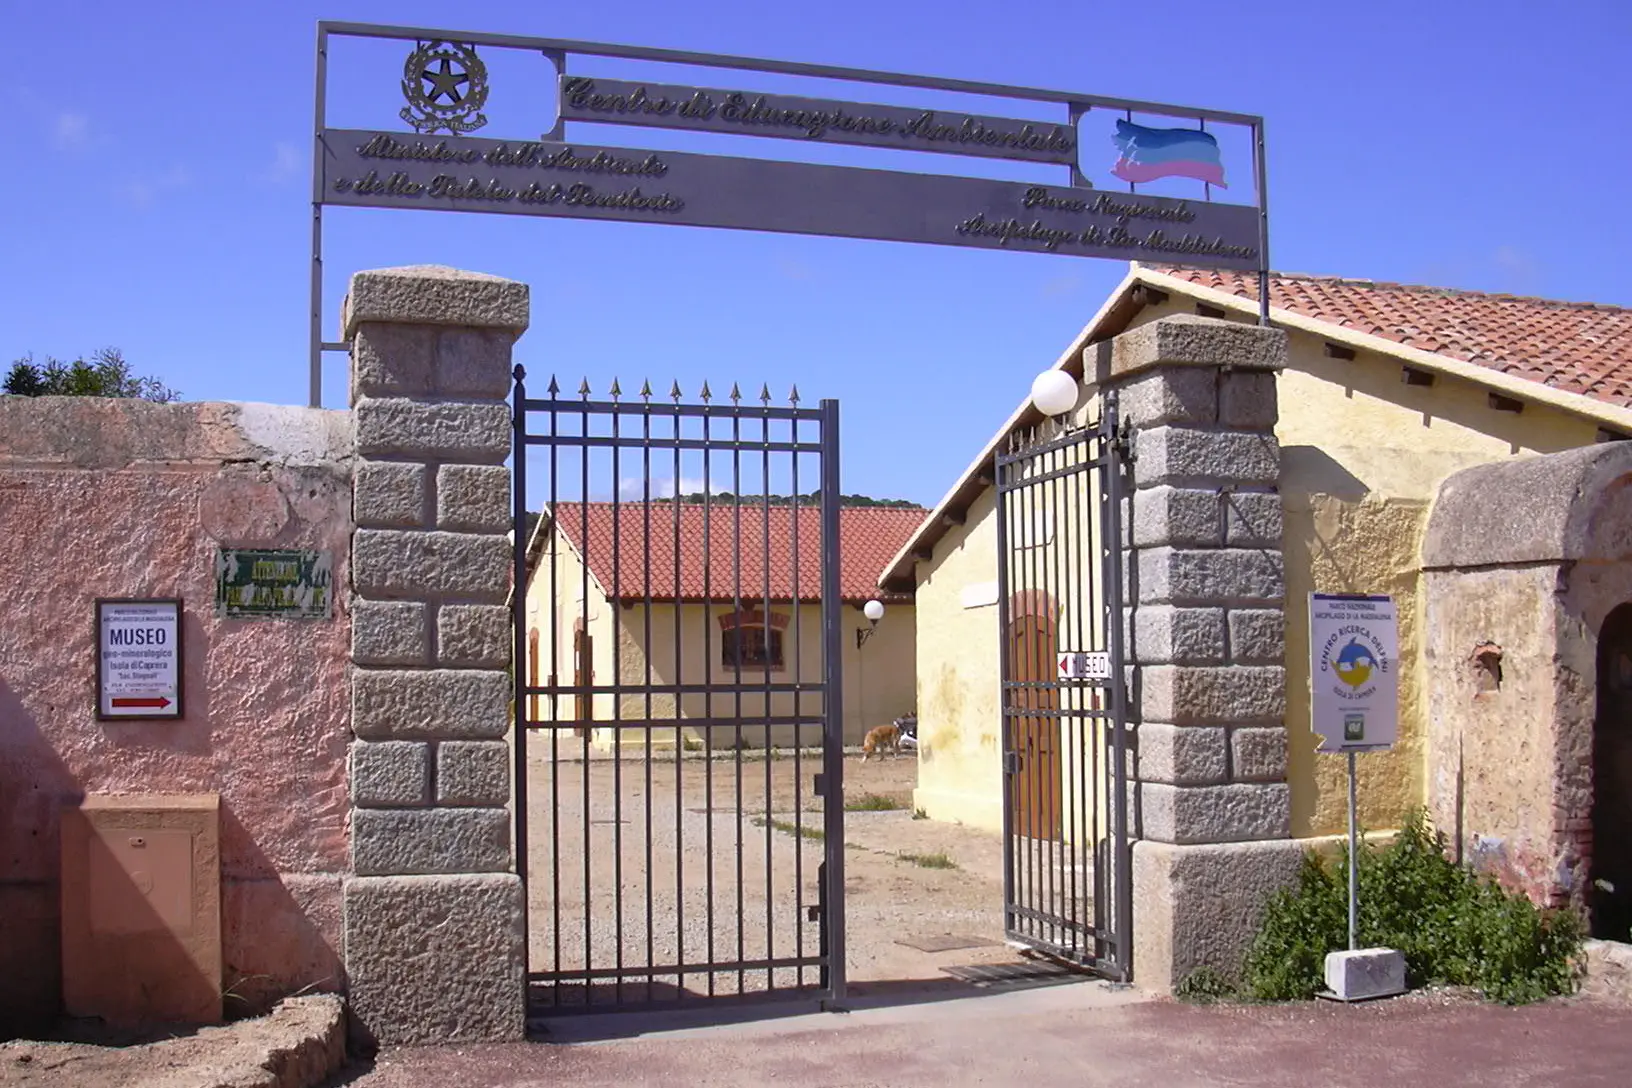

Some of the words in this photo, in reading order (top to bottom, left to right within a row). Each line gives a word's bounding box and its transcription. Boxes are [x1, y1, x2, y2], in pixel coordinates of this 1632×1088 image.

[565, 78, 675, 114] Centro
[677, 89, 717, 119] di
[719, 93, 898, 139] Educazione
[902, 110, 1075, 151] Ambientale
[356, 134, 478, 162] Ministero
[332, 177, 350, 193] e
[352, 170, 423, 197] della
[425, 173, 513, 202] Tutela
[515, 182, 560, 205] del
[562, 181, 685, 213] Territorio
[1021, 187, 1086, 212] Parco
[1086, 193, 1196, 226] Nazionale
[955, 212, 1077, 248] Arcipelago
[1079, 224, 1101, 245] di
[1103, 226, 1139, 246] La
[1138, 229, 1258, 260] Maddalena
[110, 627, 166, 645] MUSEO
[1321, 633, 1338, 672] CENTRO
[1338, 624, 1370, 640] RICERCA
[1371, 636, 1389, 673] DELFINI
[110, 661, 130, 670] Isola
[131, 661, 138, 670] di
[139, 661, 168, 671] Caprera
